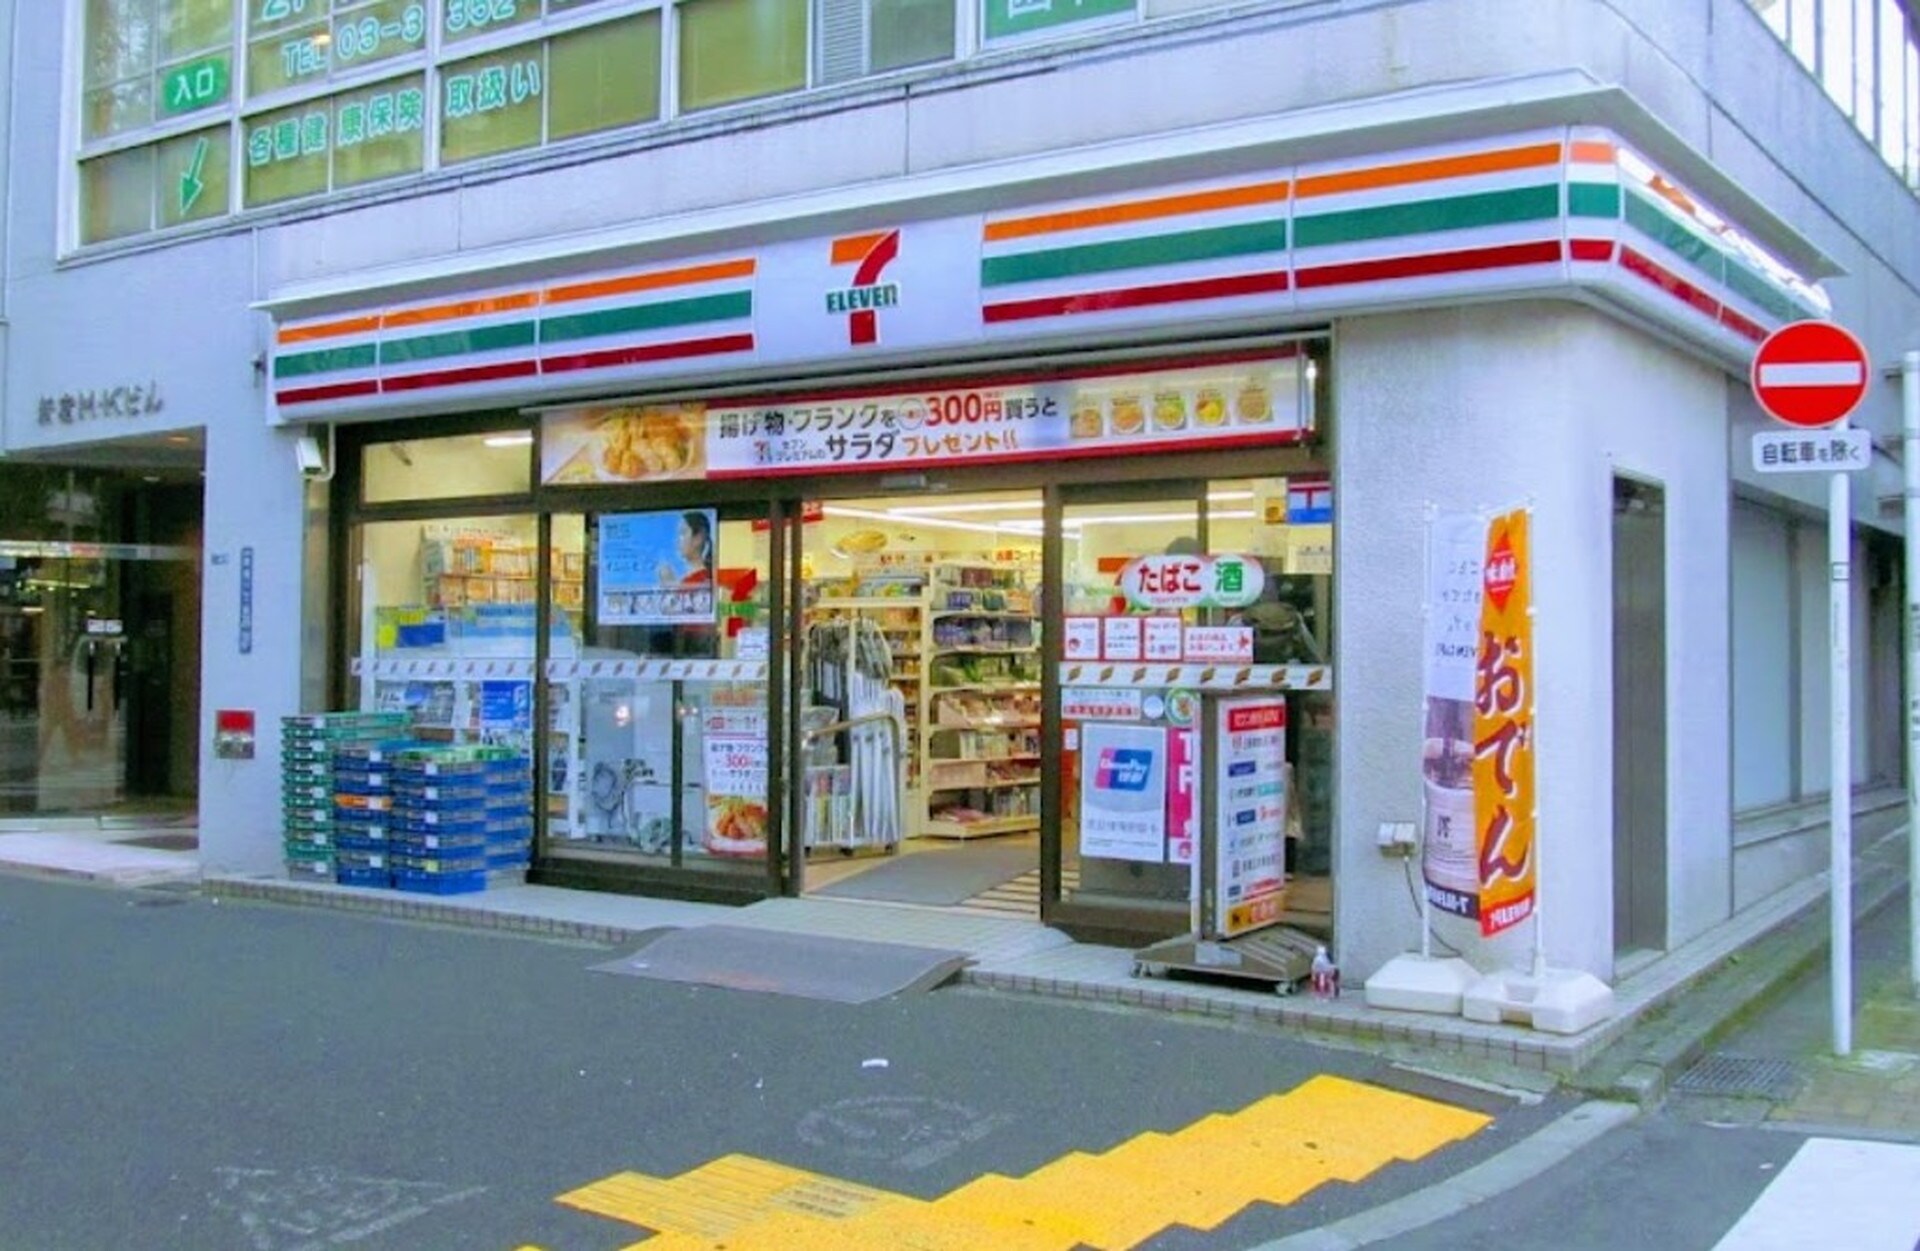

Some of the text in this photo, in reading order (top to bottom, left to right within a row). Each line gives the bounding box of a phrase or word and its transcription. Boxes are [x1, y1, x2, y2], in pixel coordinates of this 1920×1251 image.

[281, 38, 330, 77] TEL
[174, 66, 213, 105] 入口
[830, 229, 899, 345] 7
[825, 431, 900, 461] サラダ
[1763, 440, 1859, 465] 自転車を除く
[1138, 560, 1244, 594] たばこ 酒
[1474, 632, 1531, 889] おでん
